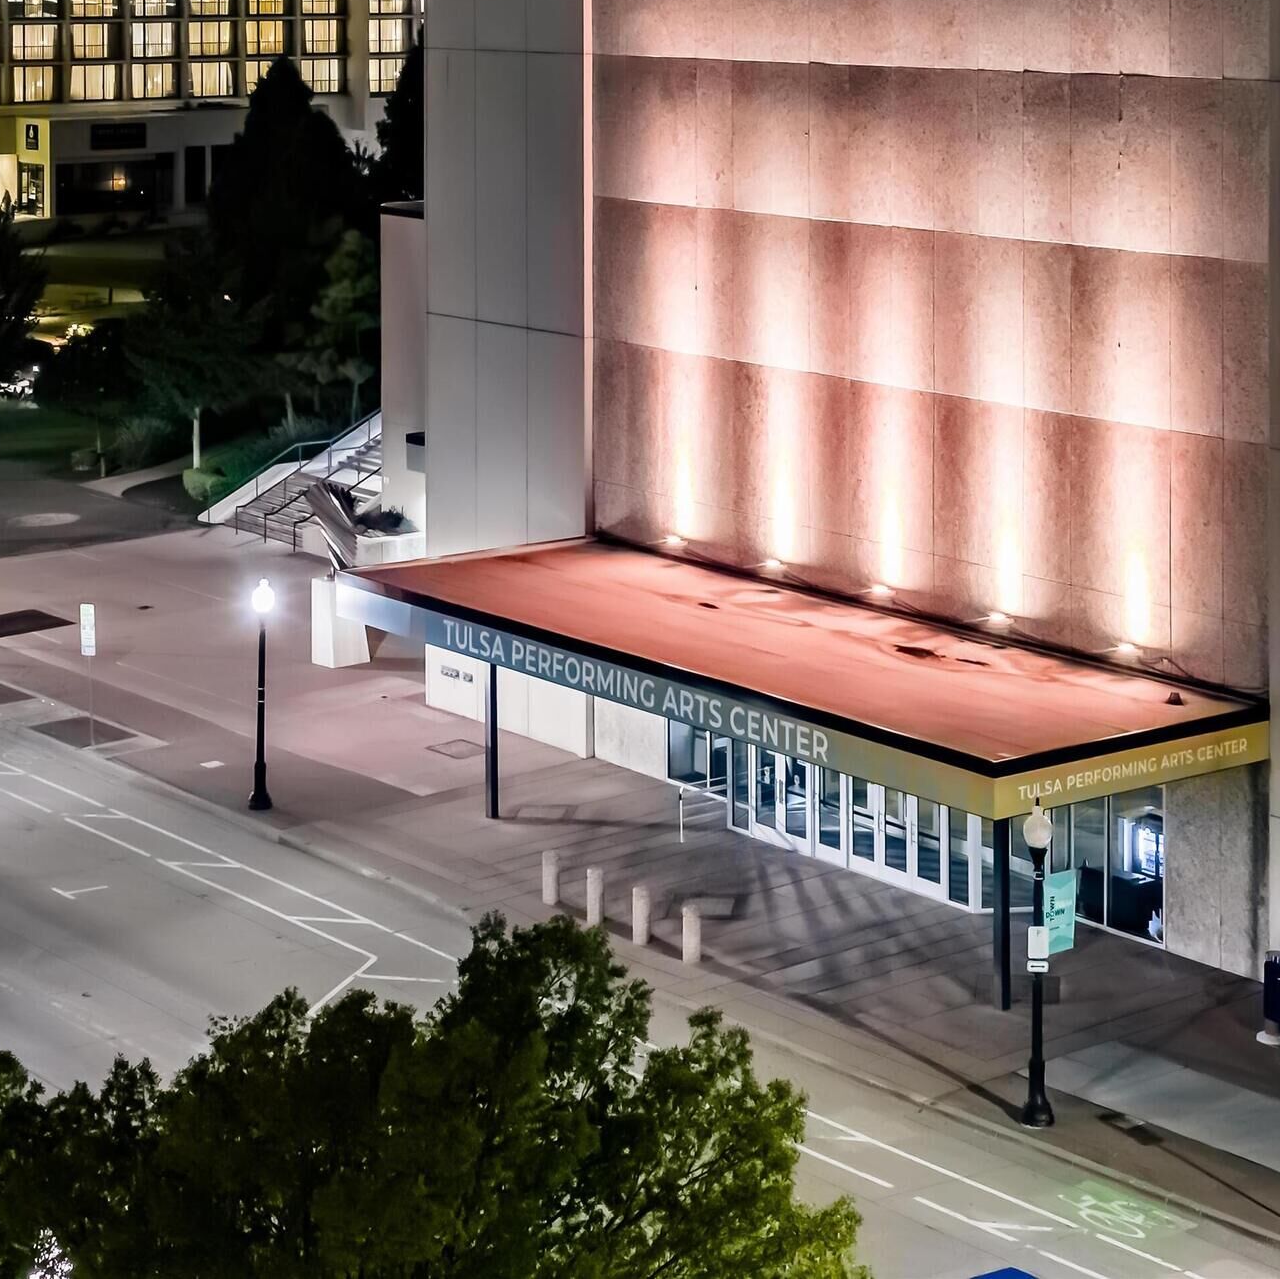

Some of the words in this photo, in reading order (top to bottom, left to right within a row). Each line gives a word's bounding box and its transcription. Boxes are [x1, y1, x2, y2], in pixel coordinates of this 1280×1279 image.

[443, 619, 505, 662] TULSA
[511, 639, 656, 708] PERFORMING
[662, 686, 723, 729] ARTS
[729, 705, 829, 763] CENTER
[1018, 778, 1064, 802] TULSA
[1066, 756, 1158, 791] PERFORMING
[1160, 749, 1195, 770] ARTS
[1197, 737, 1249, 762] CENTER
